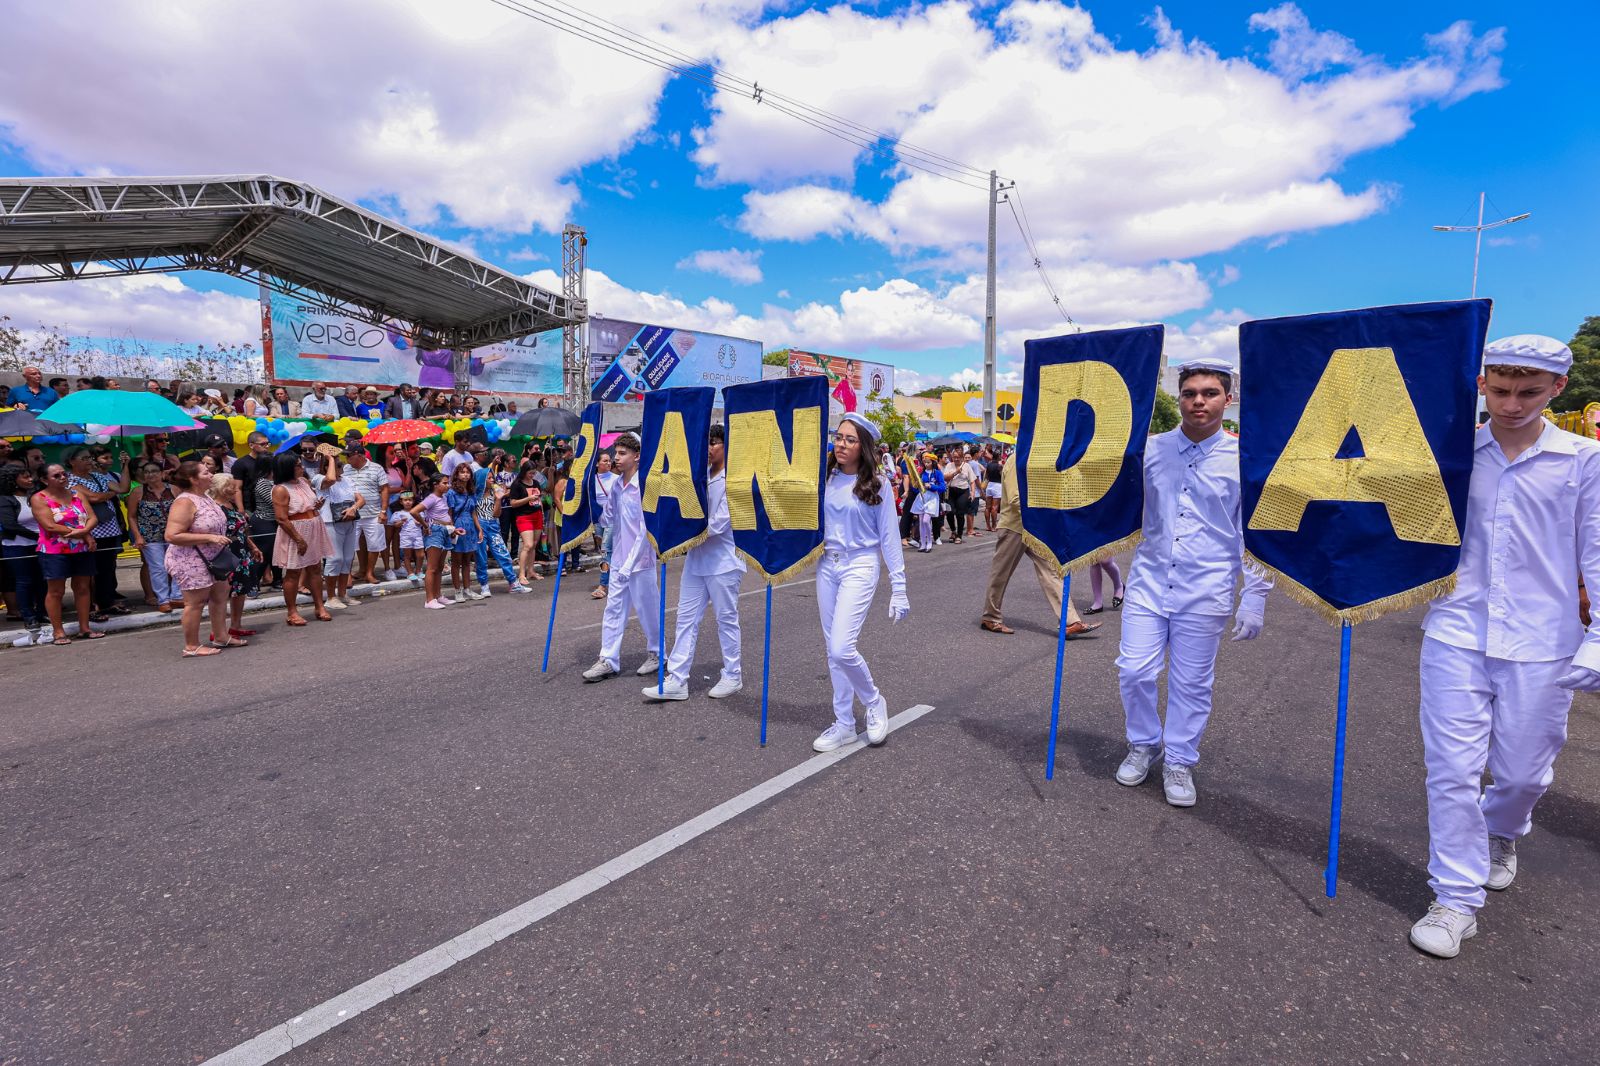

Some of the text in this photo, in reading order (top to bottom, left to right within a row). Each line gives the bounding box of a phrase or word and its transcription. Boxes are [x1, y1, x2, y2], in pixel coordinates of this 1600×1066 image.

[643, 328, 664, 351] CONFIANÇA
[648, 352, 671, 379] QUALIDADE
[650, 357, 675, 386] EXCELÊNCIA
[601, 374, 624, 400] TECNOLOGIA
